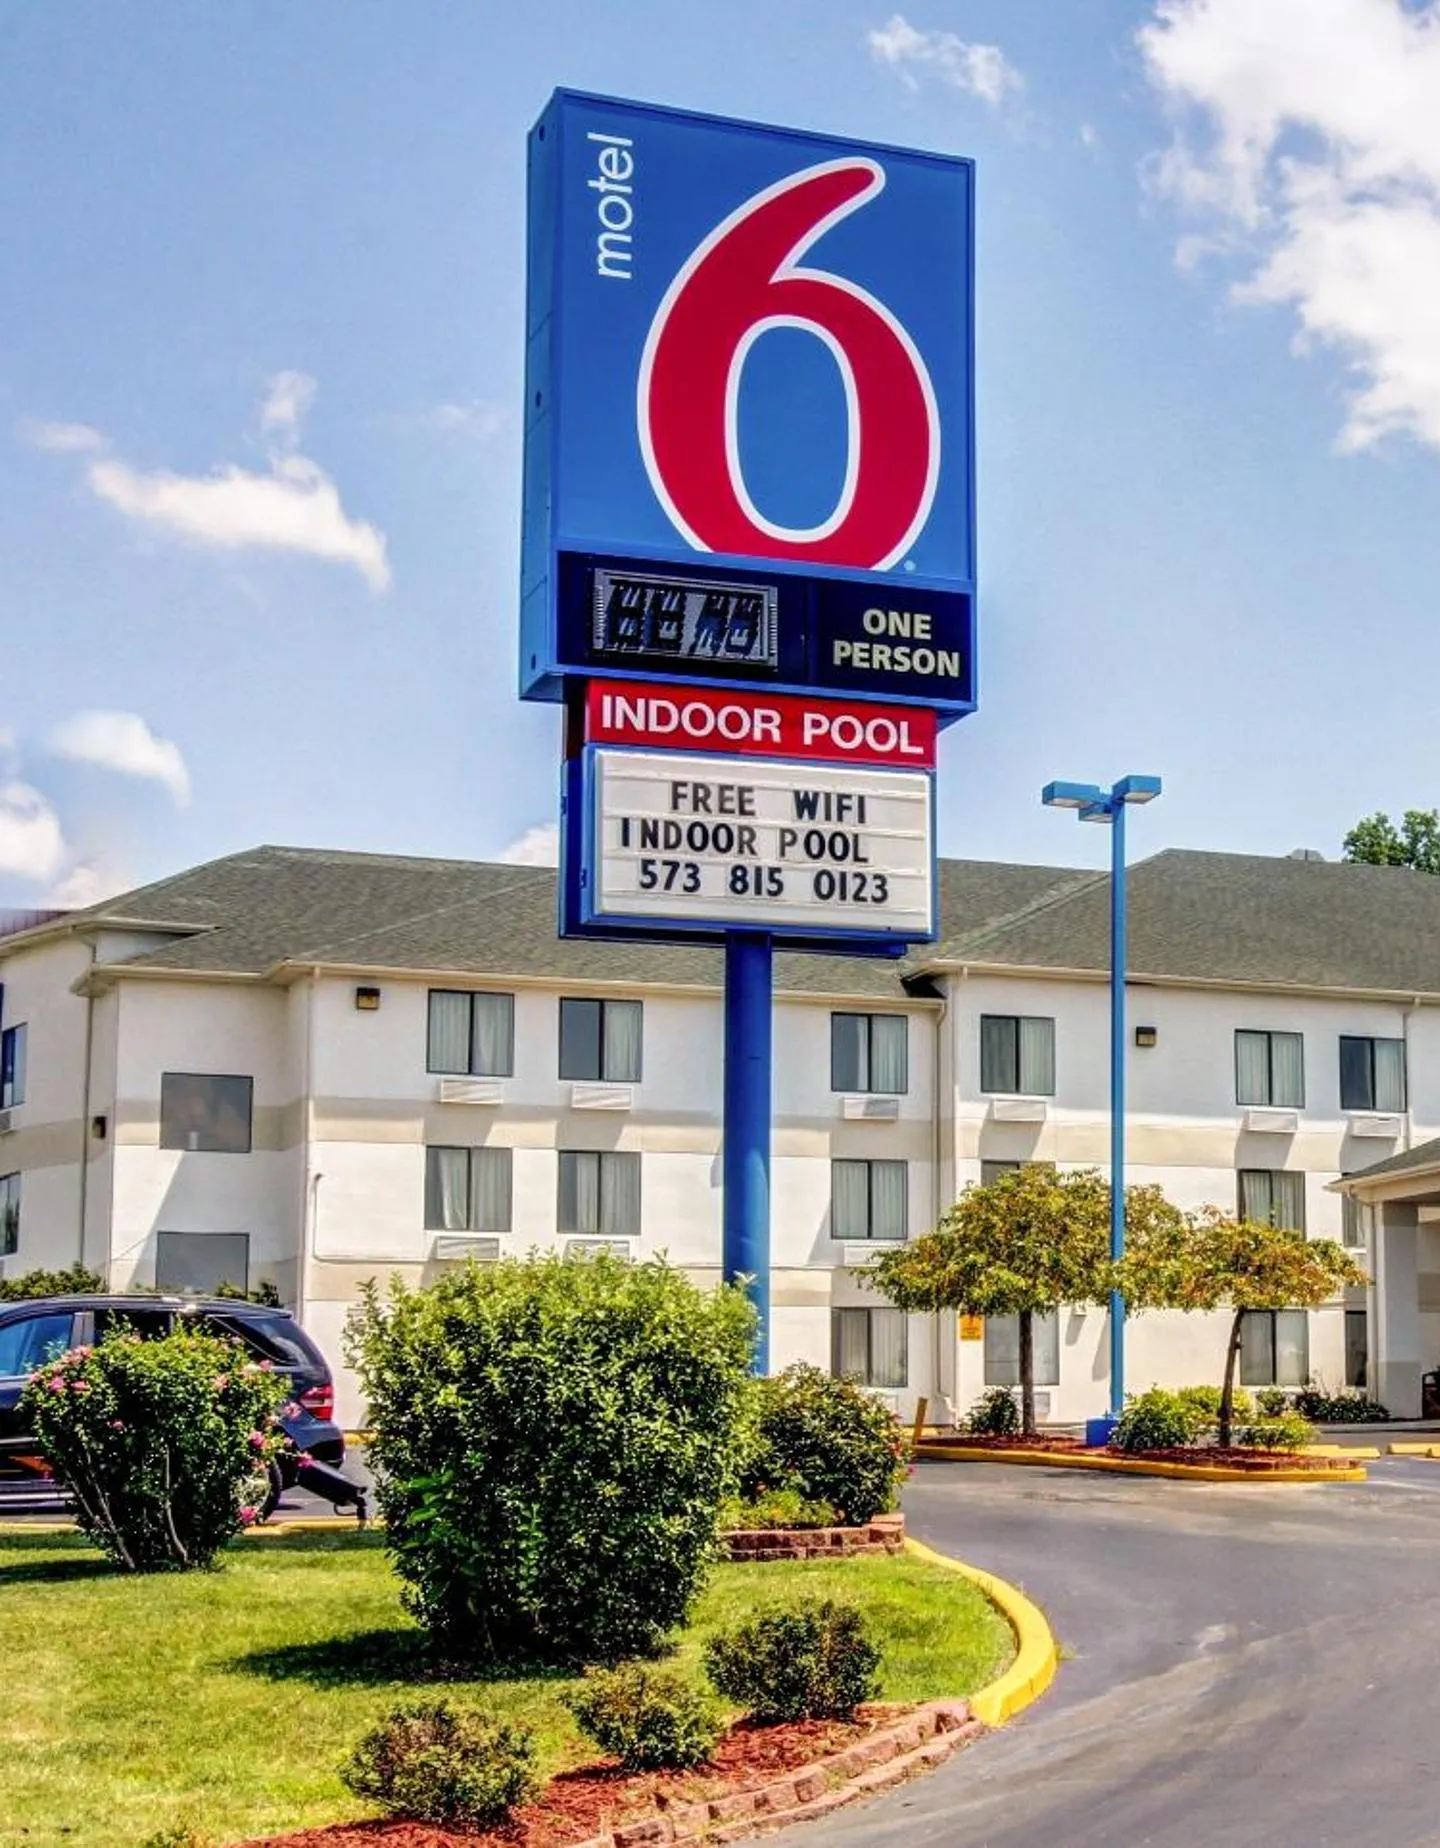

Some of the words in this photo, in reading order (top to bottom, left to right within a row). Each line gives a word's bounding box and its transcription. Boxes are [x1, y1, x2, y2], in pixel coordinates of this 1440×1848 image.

[587, 132, 634, 279] motel
[637, 156, 941, 571] 6
[862, 608, 932, 640] ONE
[832, 639, 960, 678] PERSON
[601, 695, 782, 743] INDOOR
[803, 712, 924, 755] POOL
[671, 781, 756, 816] FREE
[794, 790, 866, 824] WIFI
[620, 817, 757, 857] INDOOR
[779, 828, 869, 863] POOL
[639, 859, 701, 893] 573
[729, 864, 784, 897] 815
[813, 868, 889, 903] 0123
